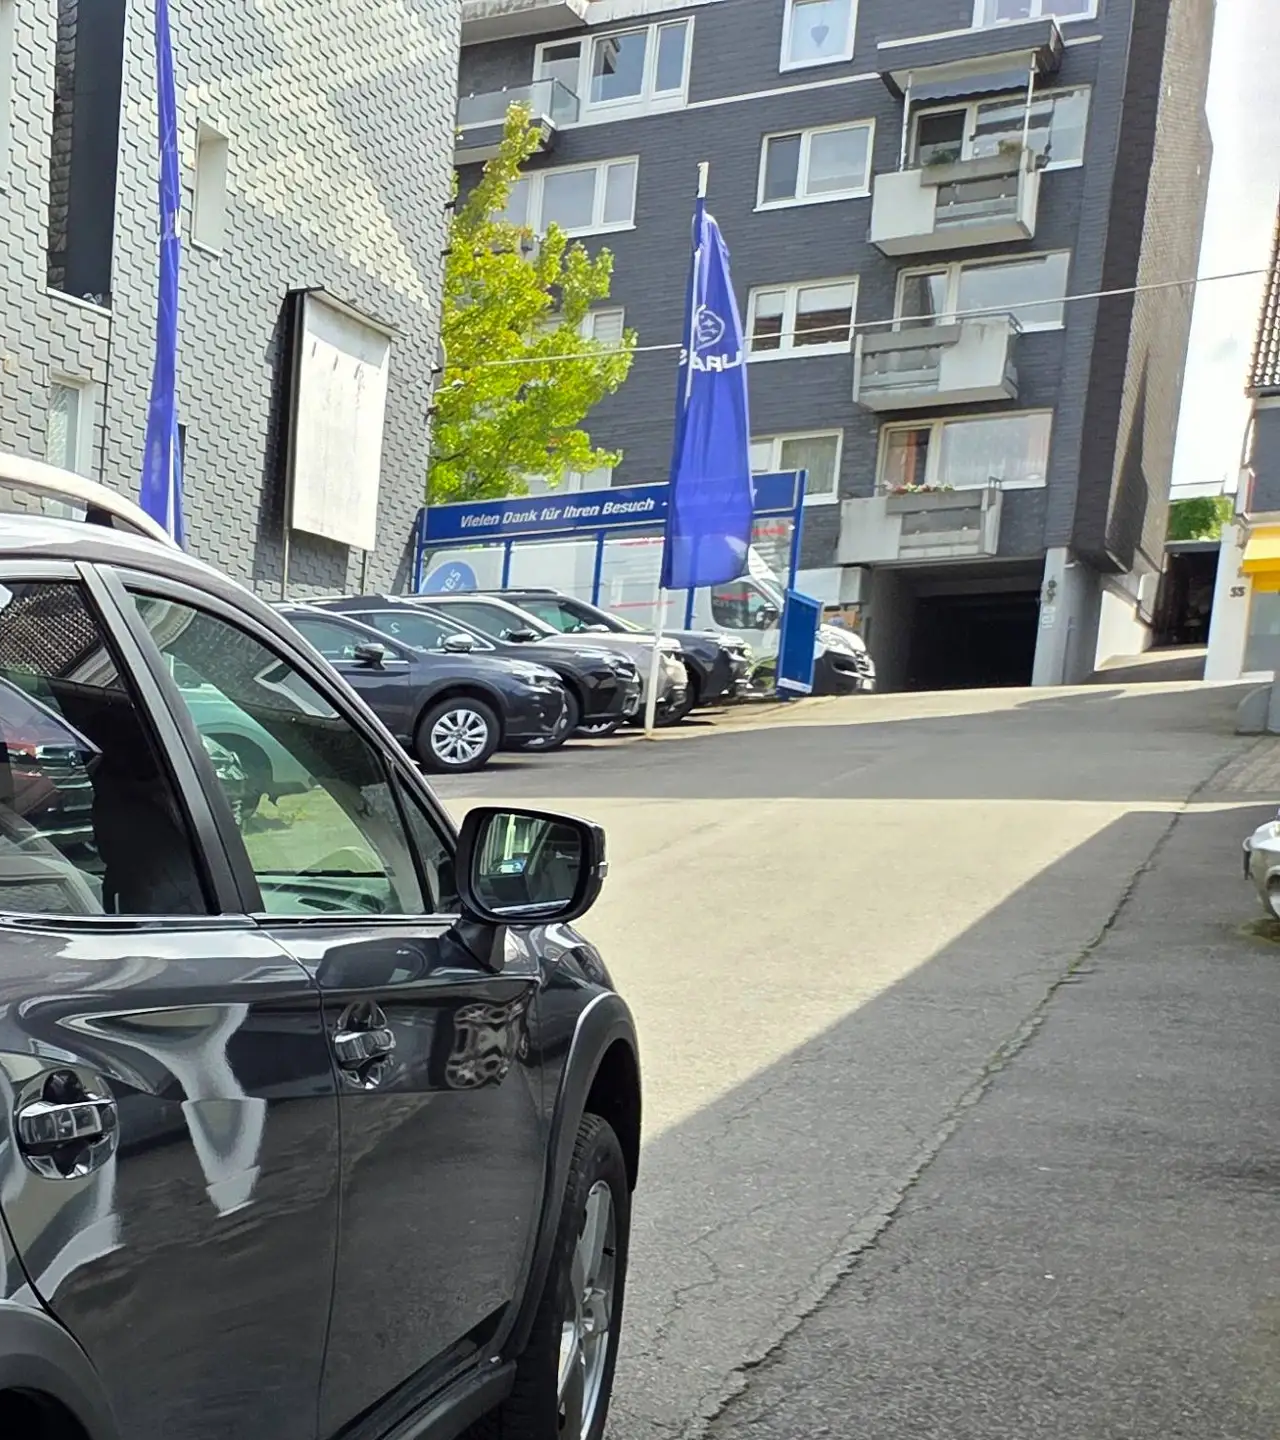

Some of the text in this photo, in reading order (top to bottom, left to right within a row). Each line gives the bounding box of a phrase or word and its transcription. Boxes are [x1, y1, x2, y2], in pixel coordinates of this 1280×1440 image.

[460, 498, 656, 529] Vielen Dank für Ihren Besuch
